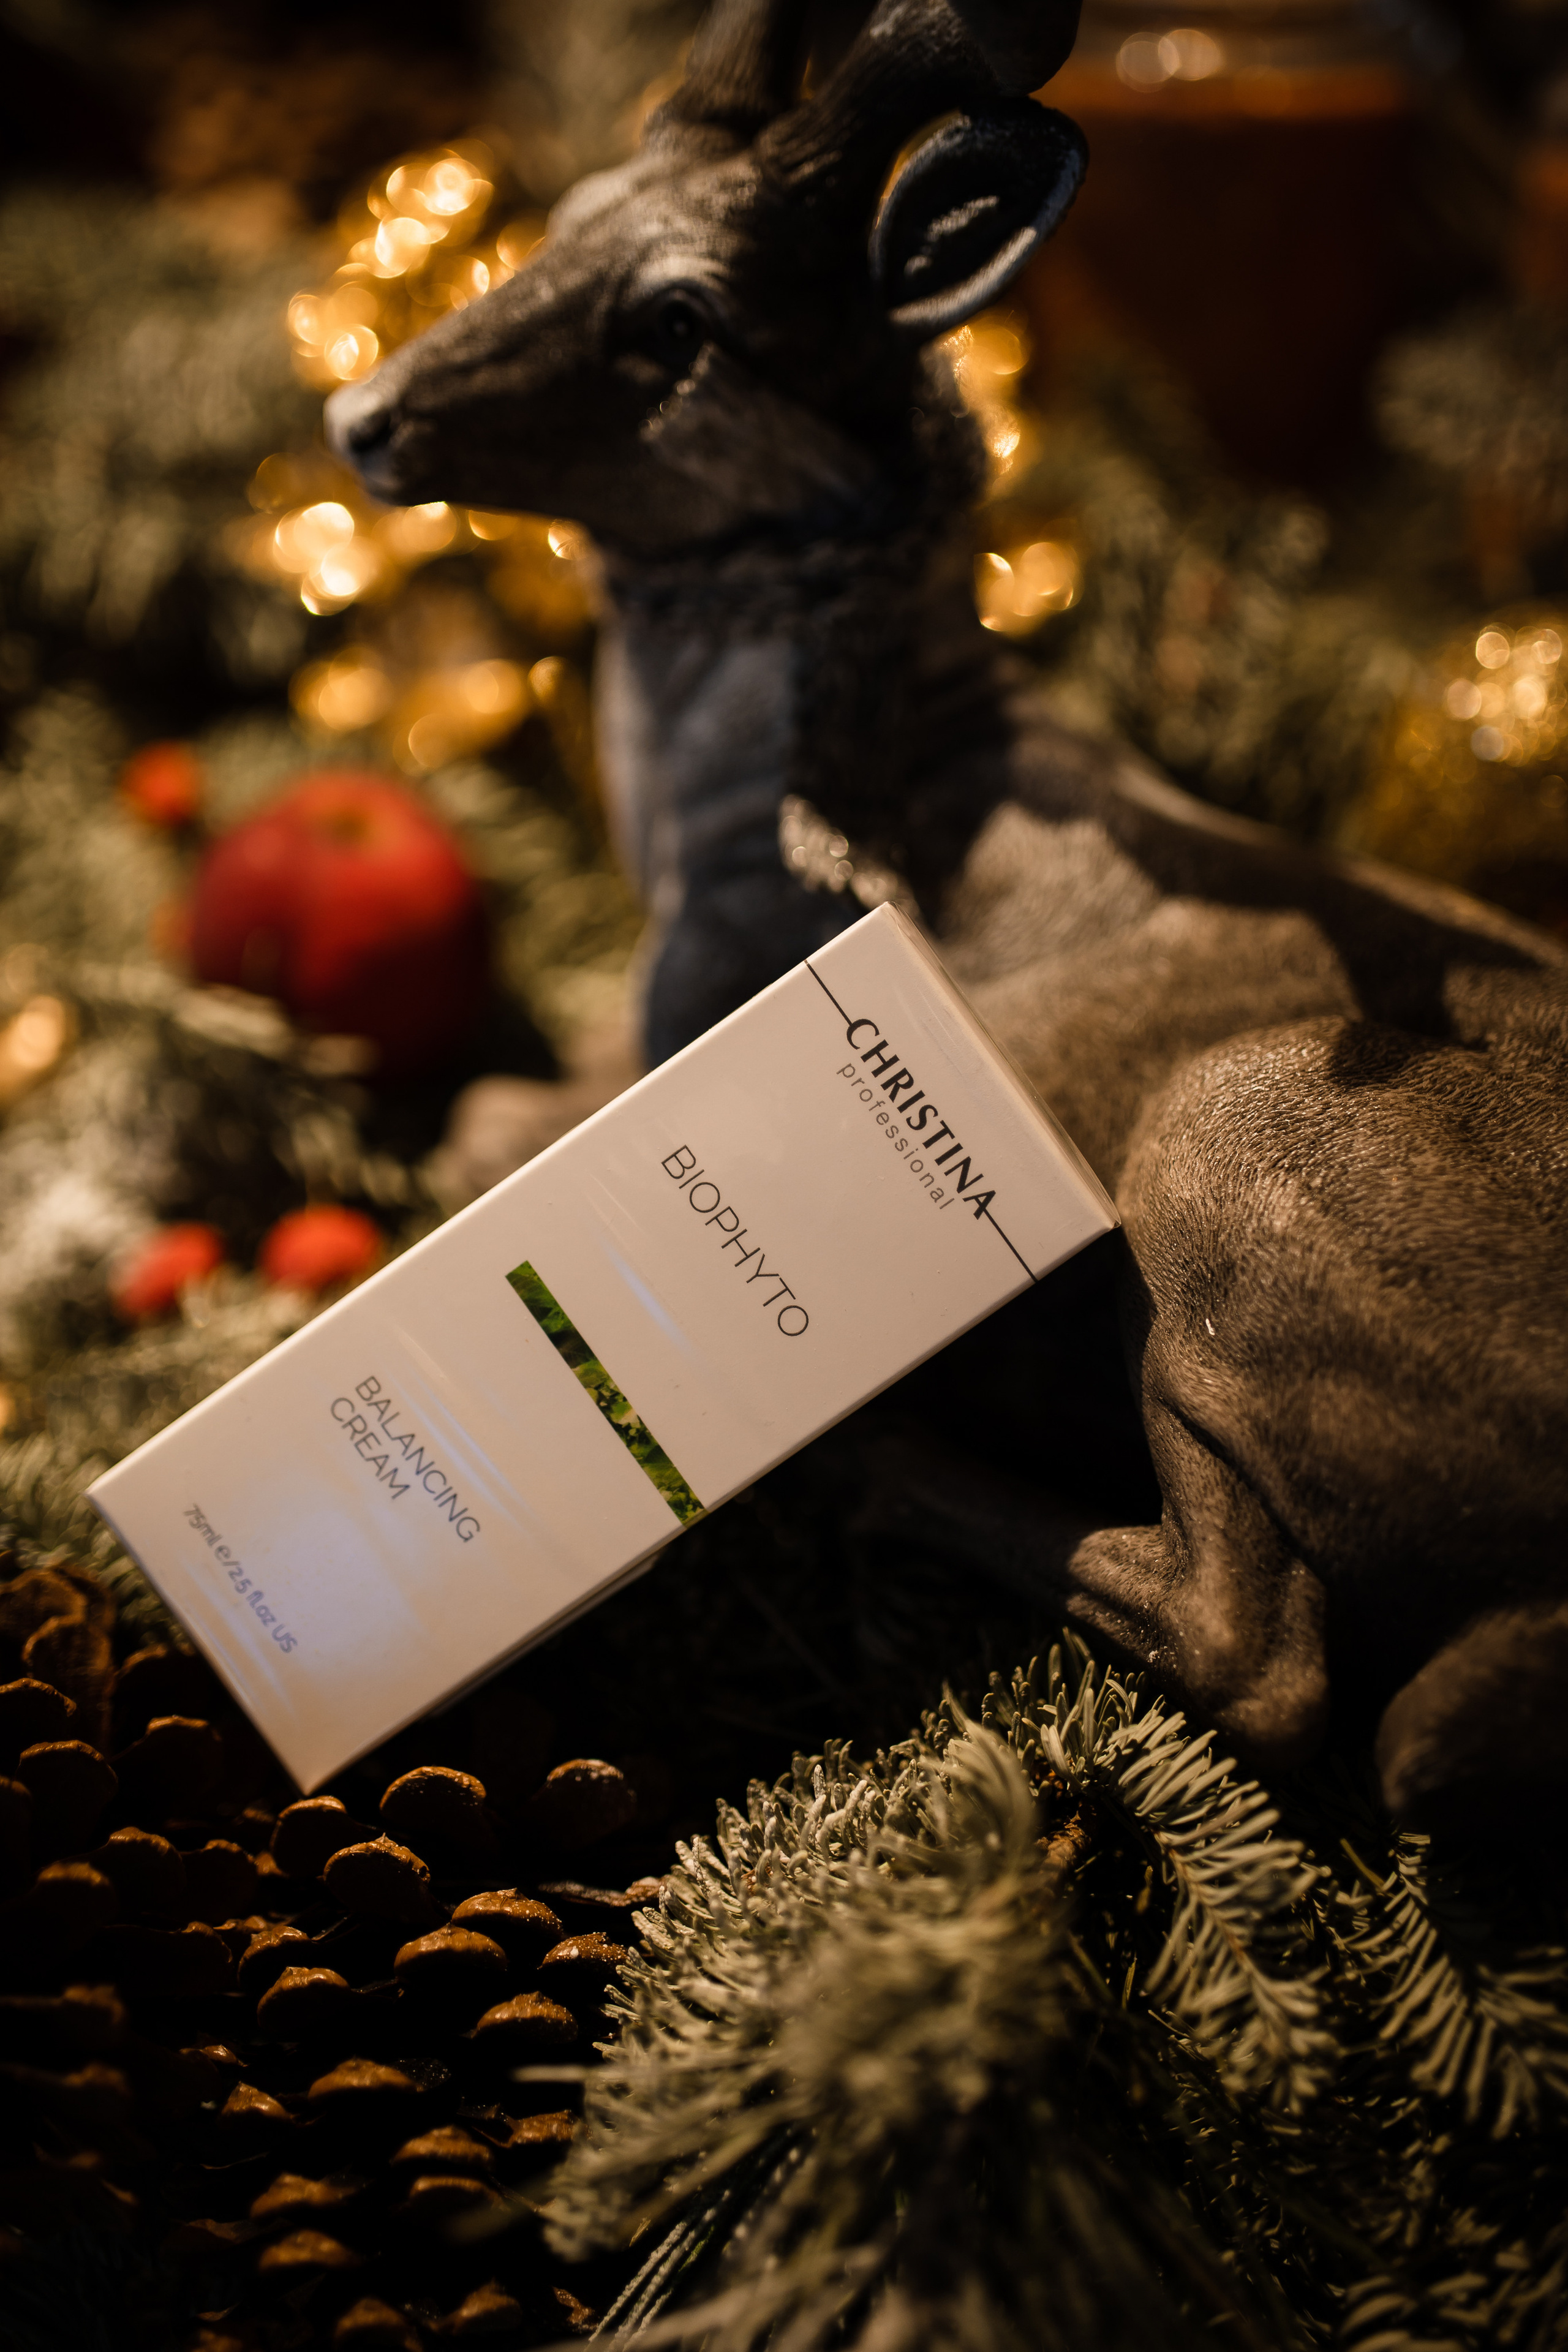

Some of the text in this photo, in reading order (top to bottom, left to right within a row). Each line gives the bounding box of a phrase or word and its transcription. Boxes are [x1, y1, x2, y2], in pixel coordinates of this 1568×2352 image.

[836, 1062, 955, 1210] professional
[846, 1018, 997, 1220] CHRISTINA
[661, 1144, 809, 1336] BIOPHYTO
[330, 1397, 410, 1499] CREAM
[355, 1376, 480, 1542] BALANCING
[271, 1624, 298, 1653] US
